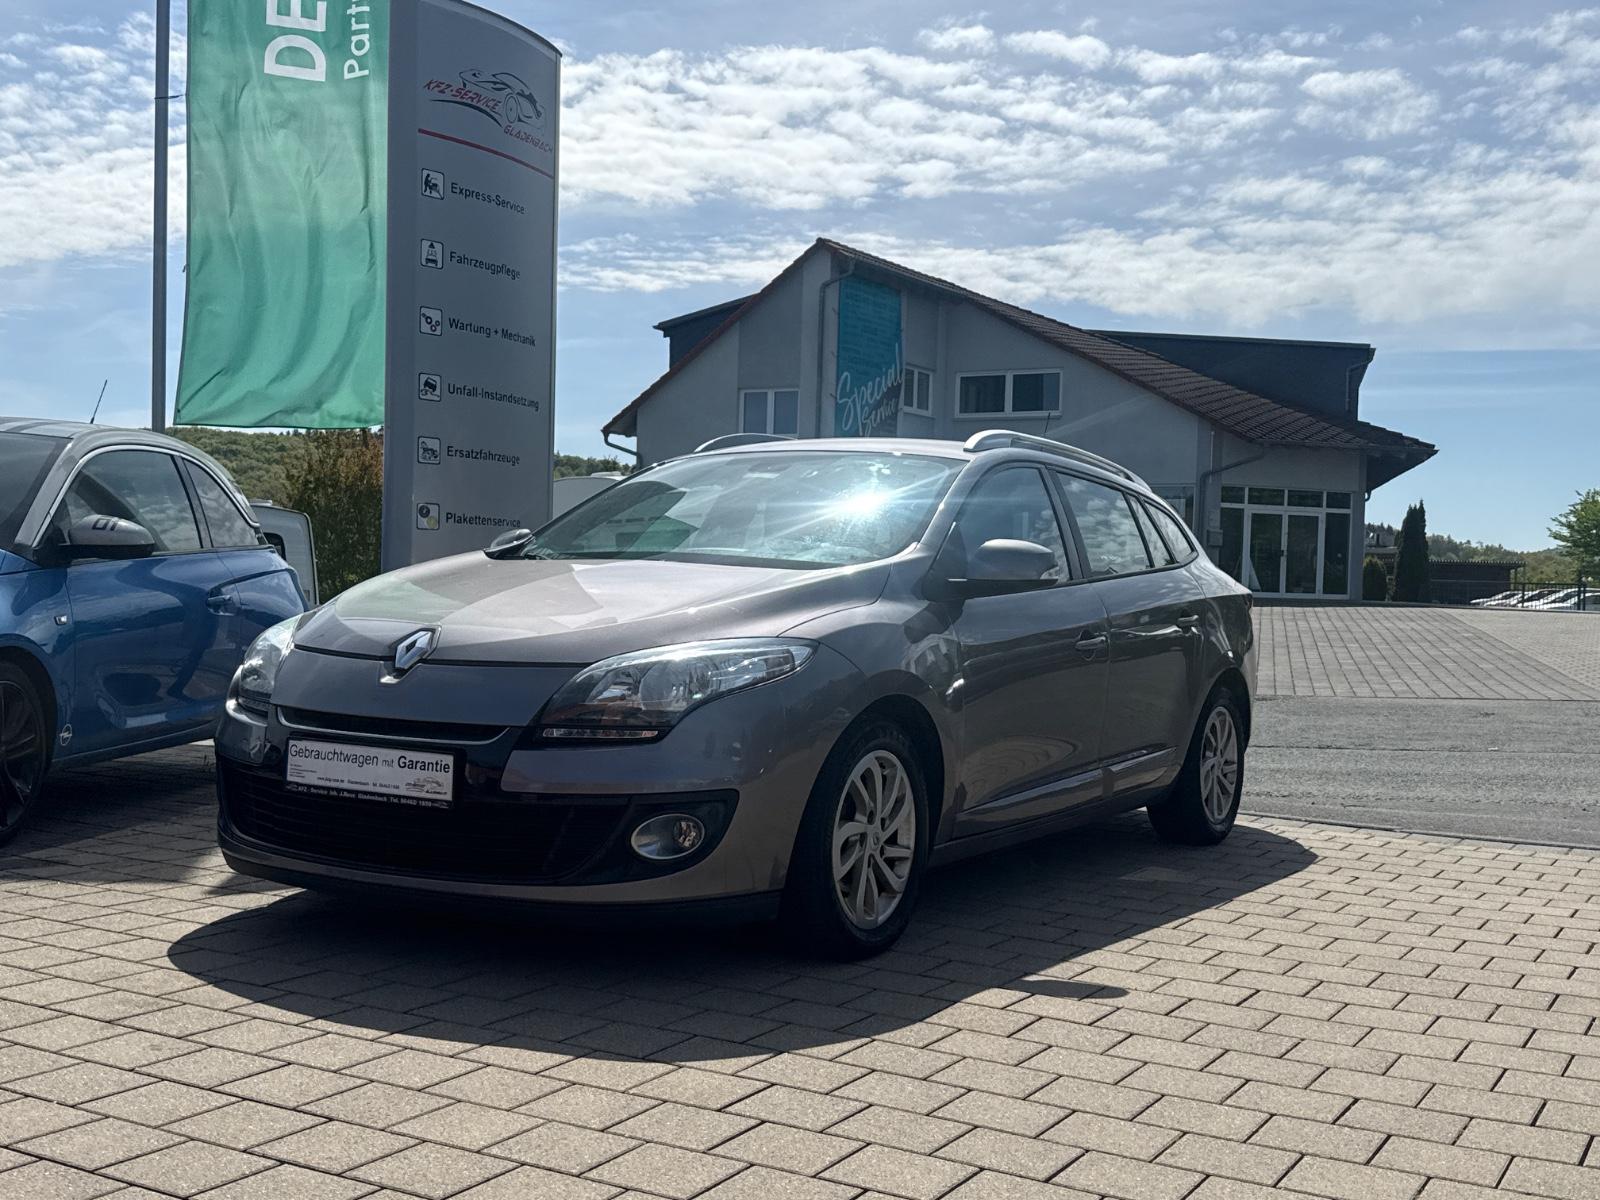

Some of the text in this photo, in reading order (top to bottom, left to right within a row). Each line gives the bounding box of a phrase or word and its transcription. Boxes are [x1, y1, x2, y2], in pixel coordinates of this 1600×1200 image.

[343, 0, 370, 80] Part
[423, 79, 502, 110] KFZ-SERVICE
[450, 182, 526, 215] Express-Service
[449, 251, 521, 280] Fahrzeugpflege
[448, 317, 491, 339] Wartung
[501, 328, 537, 348] Mechanik
[447, 383, 539, 411] Unfall-Instandsetzung
[837, 342, 905, 437] Special
[446, 445, 521, 467] Ersatzfahrzeuge
[445, 512, 522, 529] Plakettenservice
[290, 744, 450, 774] Gebrauchtwagen mit Garantie
